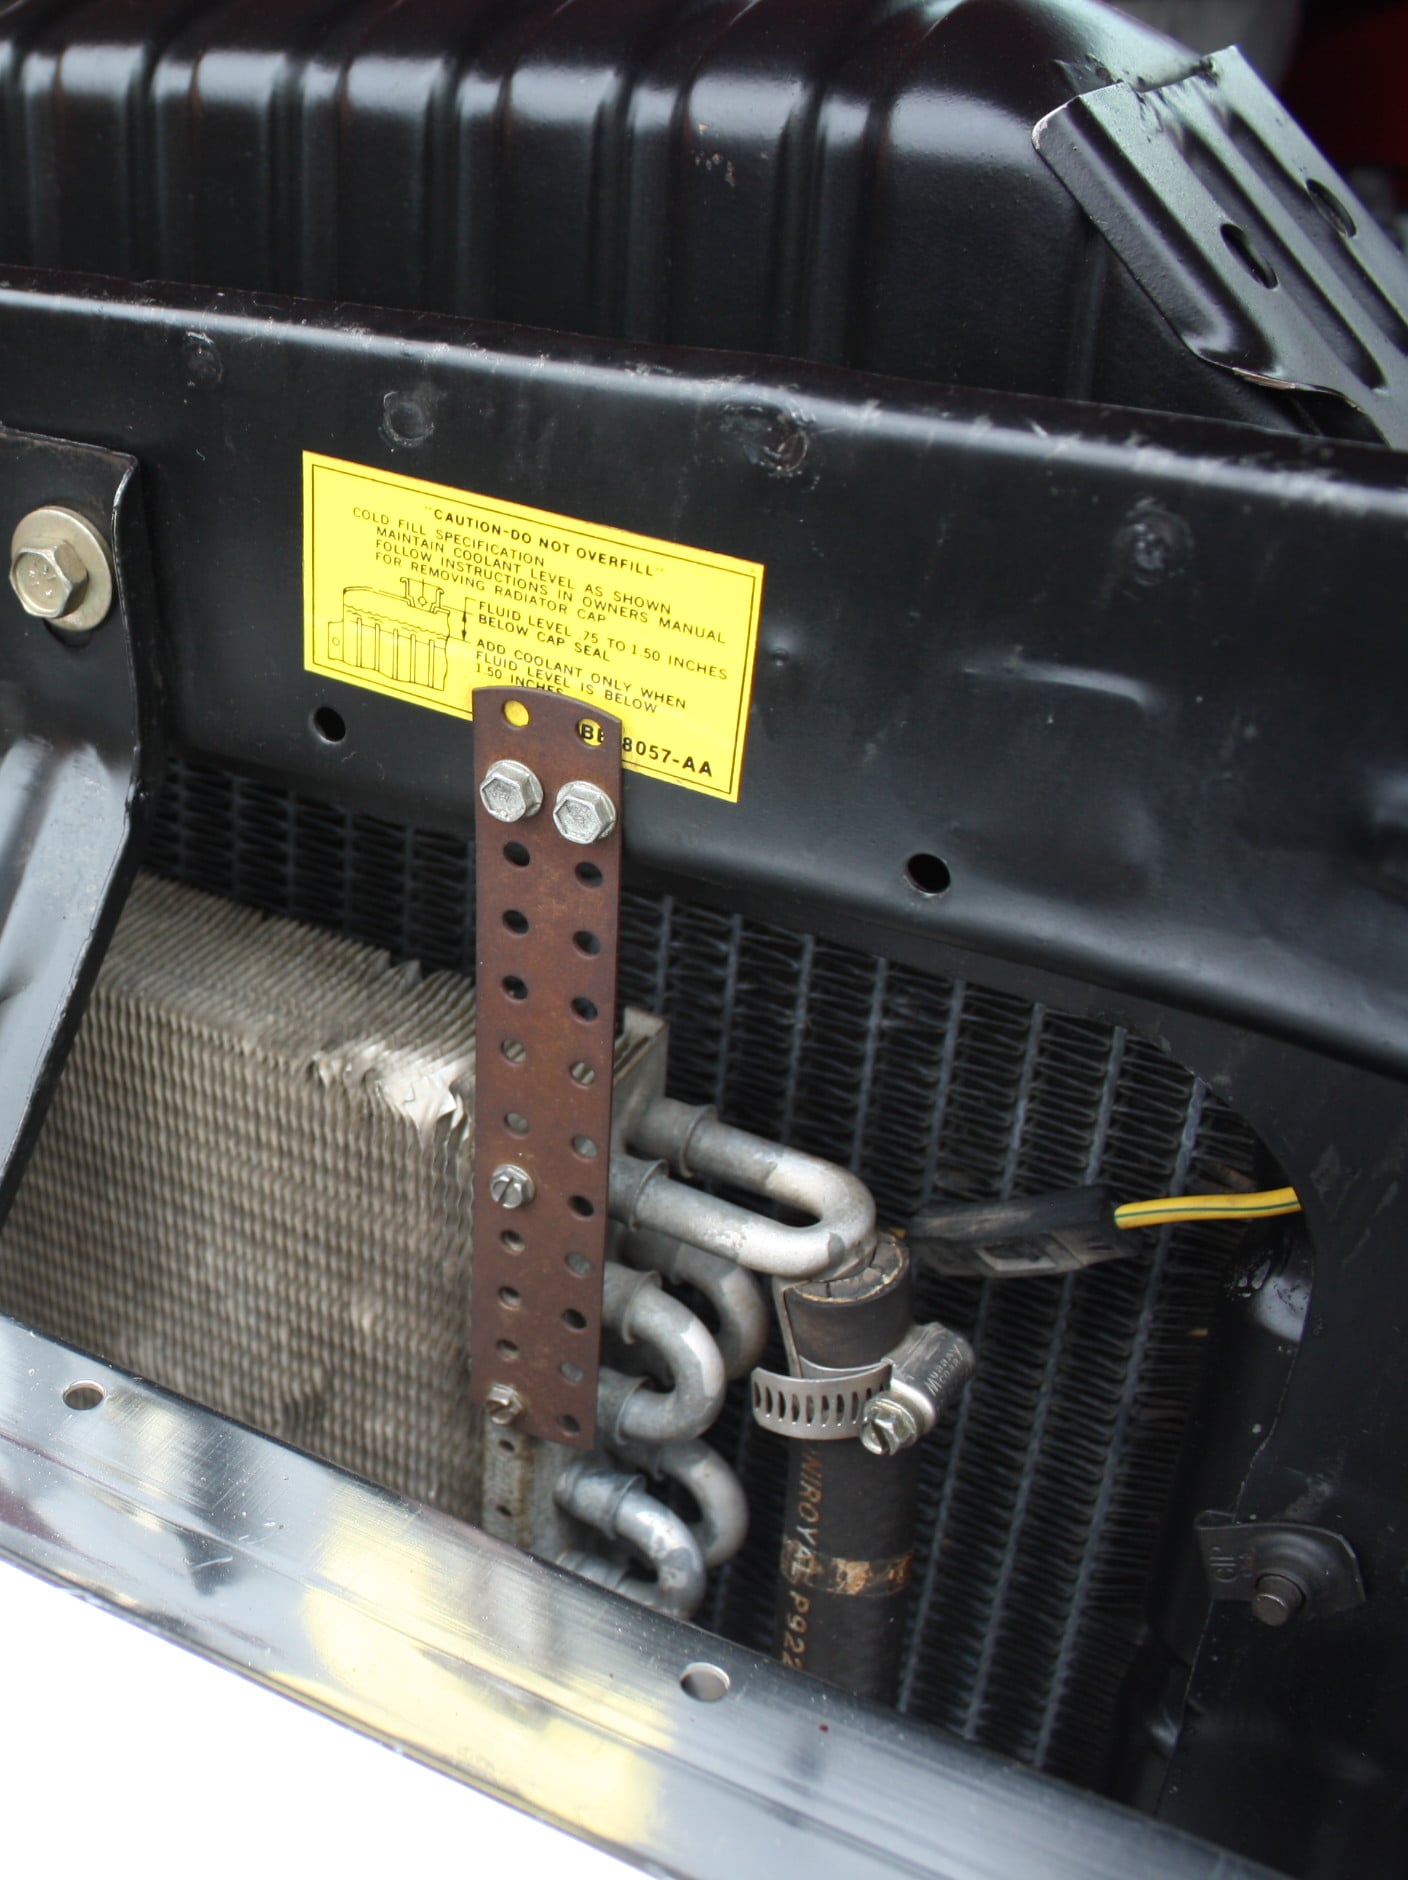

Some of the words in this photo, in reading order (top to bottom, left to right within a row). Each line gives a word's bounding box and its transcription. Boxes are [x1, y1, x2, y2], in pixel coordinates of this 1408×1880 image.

[353, 506, 390, 525] COLD
[398, 519, 426, 536] FILL
[436, 529, 545, 567] SPECIFICATION
[376, 526, 445, 553] MAINTAIN
[453, 547, 521, 574] COOLANT
[530, 568, 575, 590] LEVEL
[584, 584, 604, 597] AS
[614, 590, 672, 616] SHOWN
[539, 537, 570, 554] NOT
[375, 552, 402, 566] FOR
[411, 561, 485, 591] REMOVING
[495, 585, 568, 615] RADIATOR
[577, 608, 607, 624] CAP
[375, 540, 432, 562] FOLLOW
[441, 557, 549, 597] INSTRUCTIONS
[558, 590, 573, 602] IN
[582, 596, 648, 623] OWNERS
[658, 617, 726, 645] MANUAL
[475, 663, 503, 680] 1.50
[478, 613, 528, 636] BELOW
[536, 631, 565, 647] CAP
[574, 642, 611, 662] SEAL
[478, 601, 521, 621] FLUID
[528, 615, 572, 637] LEVEL
[607, 637, 626, 652] TO
[631, 644, 661, 662] 1.50
[668, 654, 728, 680] INCHES
[475, 650, 518, 671] FLUID
[527, 666, 571, 689] LEVEL
[581, 682, 595, 696] IS
[604, 689, 658, 714] BELOW
[476, 638, 506, 655] ADD
[514, 649, 583, 677] COOLANT
[591, 673, 632, 692] ONLY
[640, 687, 686, 710] WHEN
[790, 1449, 824, 1581] NIROYAL
